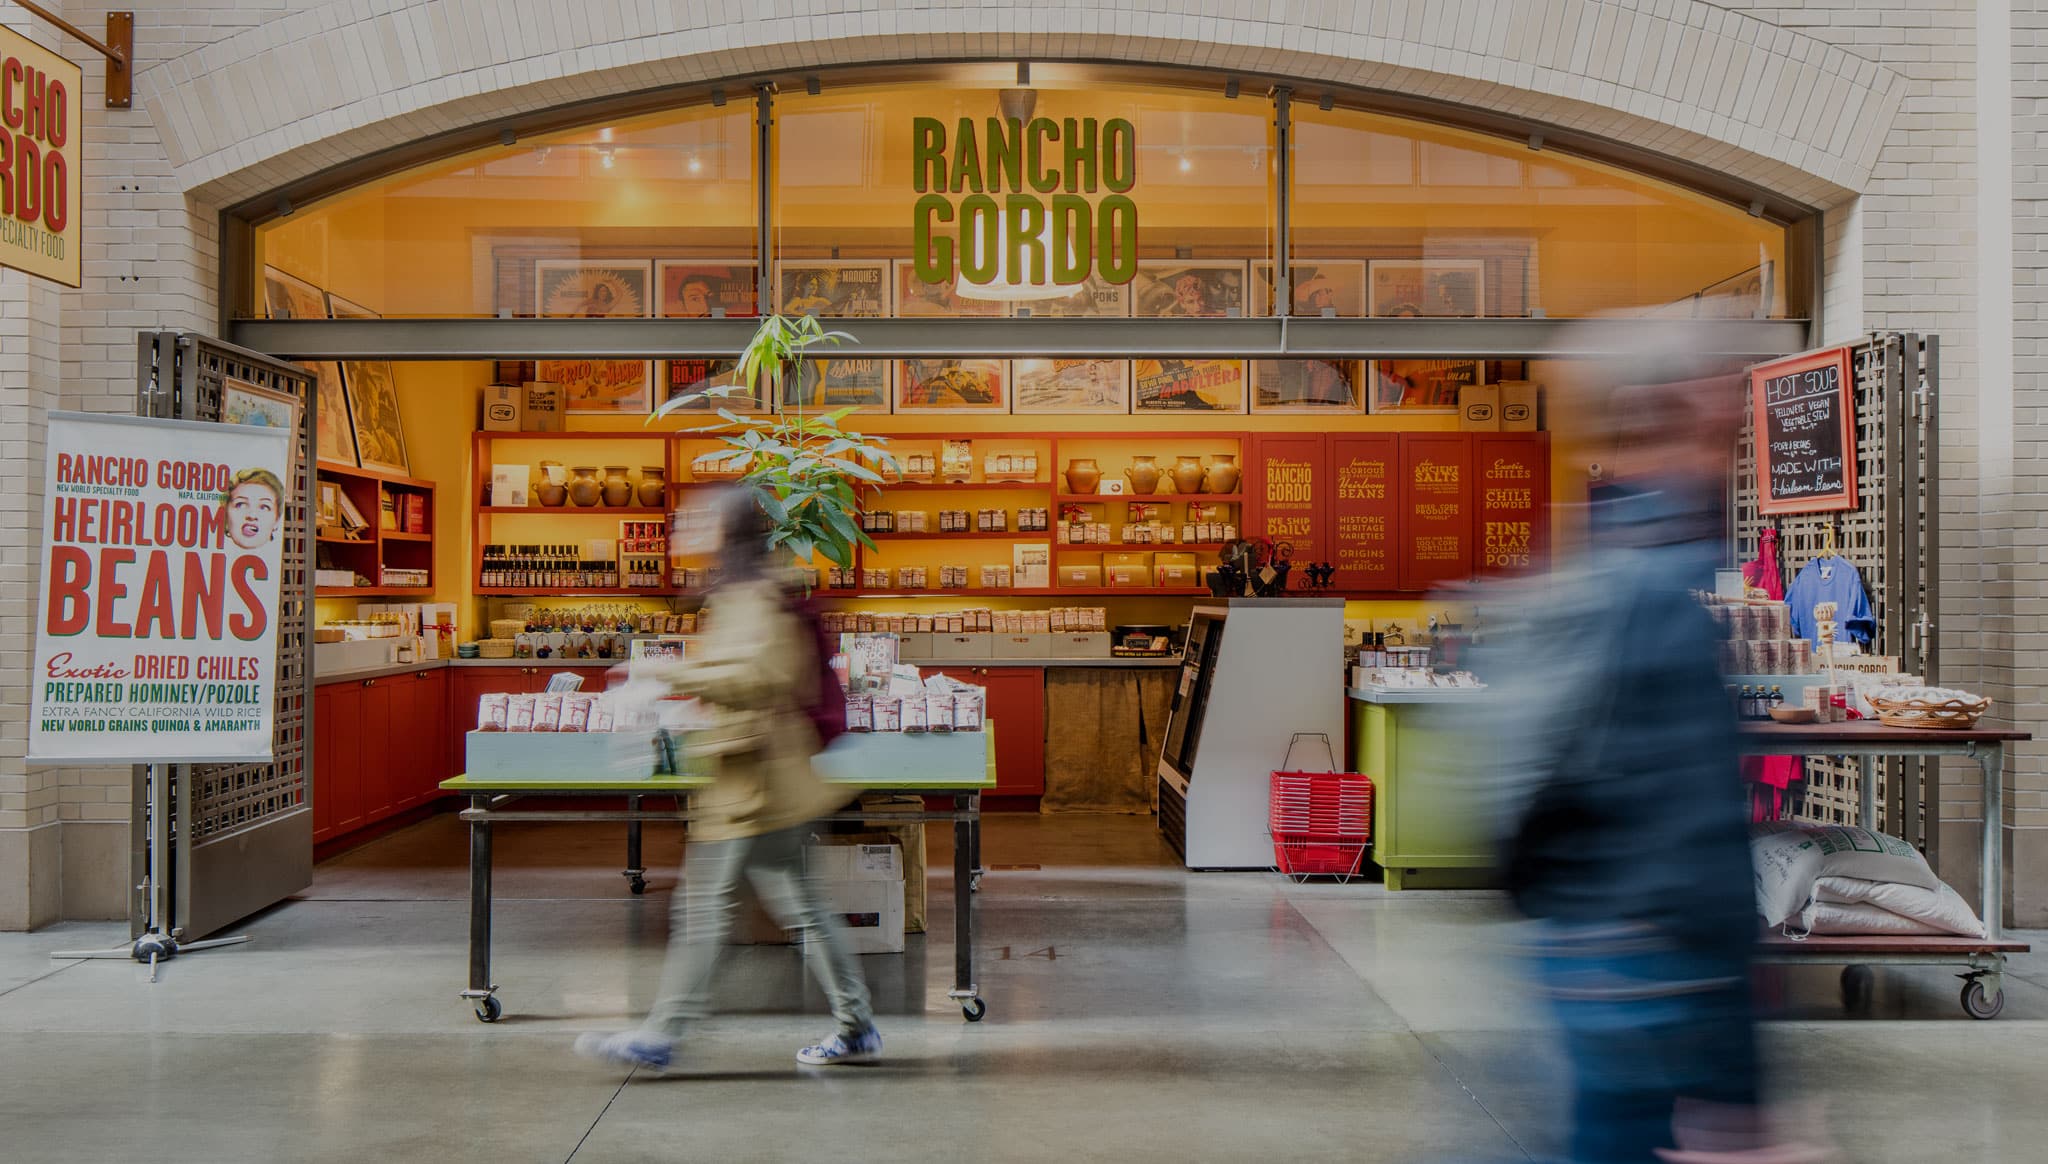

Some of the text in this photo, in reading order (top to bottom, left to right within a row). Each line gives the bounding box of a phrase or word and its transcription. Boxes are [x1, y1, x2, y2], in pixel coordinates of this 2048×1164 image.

[1, 56, 67, 148] CHO
[913, 117, 1136, 193] RANCHO
[914, 193, 1138, 285] GORDO
[41, 231, 65, 261] FOOD
[1766, 366, 1838, 402] HOT SOUP
[1808, 397, 1830, 411] VEGAN
[1266, 457, 1302, 467] Welcome
[1494, 458, 1525, 470] Exotic
[1772, 457, 1842, 476] MADE WITH
[57, 453, 231, 492] RANCHO GORDO
[1266, 467, 1312, 483] RANCHO
[1415, 465, 1458, 473] ANCIENT
[1486, 470, 1530, 478] CHILES
[1338, 478, 1384, 489] Heirloom
[1415, 472, 1458, 482] SALTS
[56, 484, 139, 497] NEW WORLD SPECIALTY FOOD
[1266, 483, 1312, 502] GORDO
[1338, 489, 1384, 498] BEANS
[1486, 492, 1530, 501] CHILE
[1486, 501, 1530, 509] POWDER
[53, 497, 225, 549] HEIRLOOM
[1267, 517, 1310, 525] WE SHIP
[1267, 525, 1311, 536] DAILY
[1485, 522, 1530, 535] FINE
[1486, 536, 1530, 547] CLAY
[1339, 550, 1384, 558] ORIGINS
[1486, 554, 1529, 567] POTS
[1339, 563, 1384, 571] AMERICAS
[46, 545, 268, 641] BEANS
[46, 652, 260, 681] Exotic DRIED CHILES
[45, 682, 261, 704] PREPARED HOMINEY/POZOLE
[42, 706, 261, 717] EXTRA FANCY CALIFORNIA WILD RICE
[42, 719, 261, 733] NEW WORLD GRAINS QUINOA & AMARANTH
